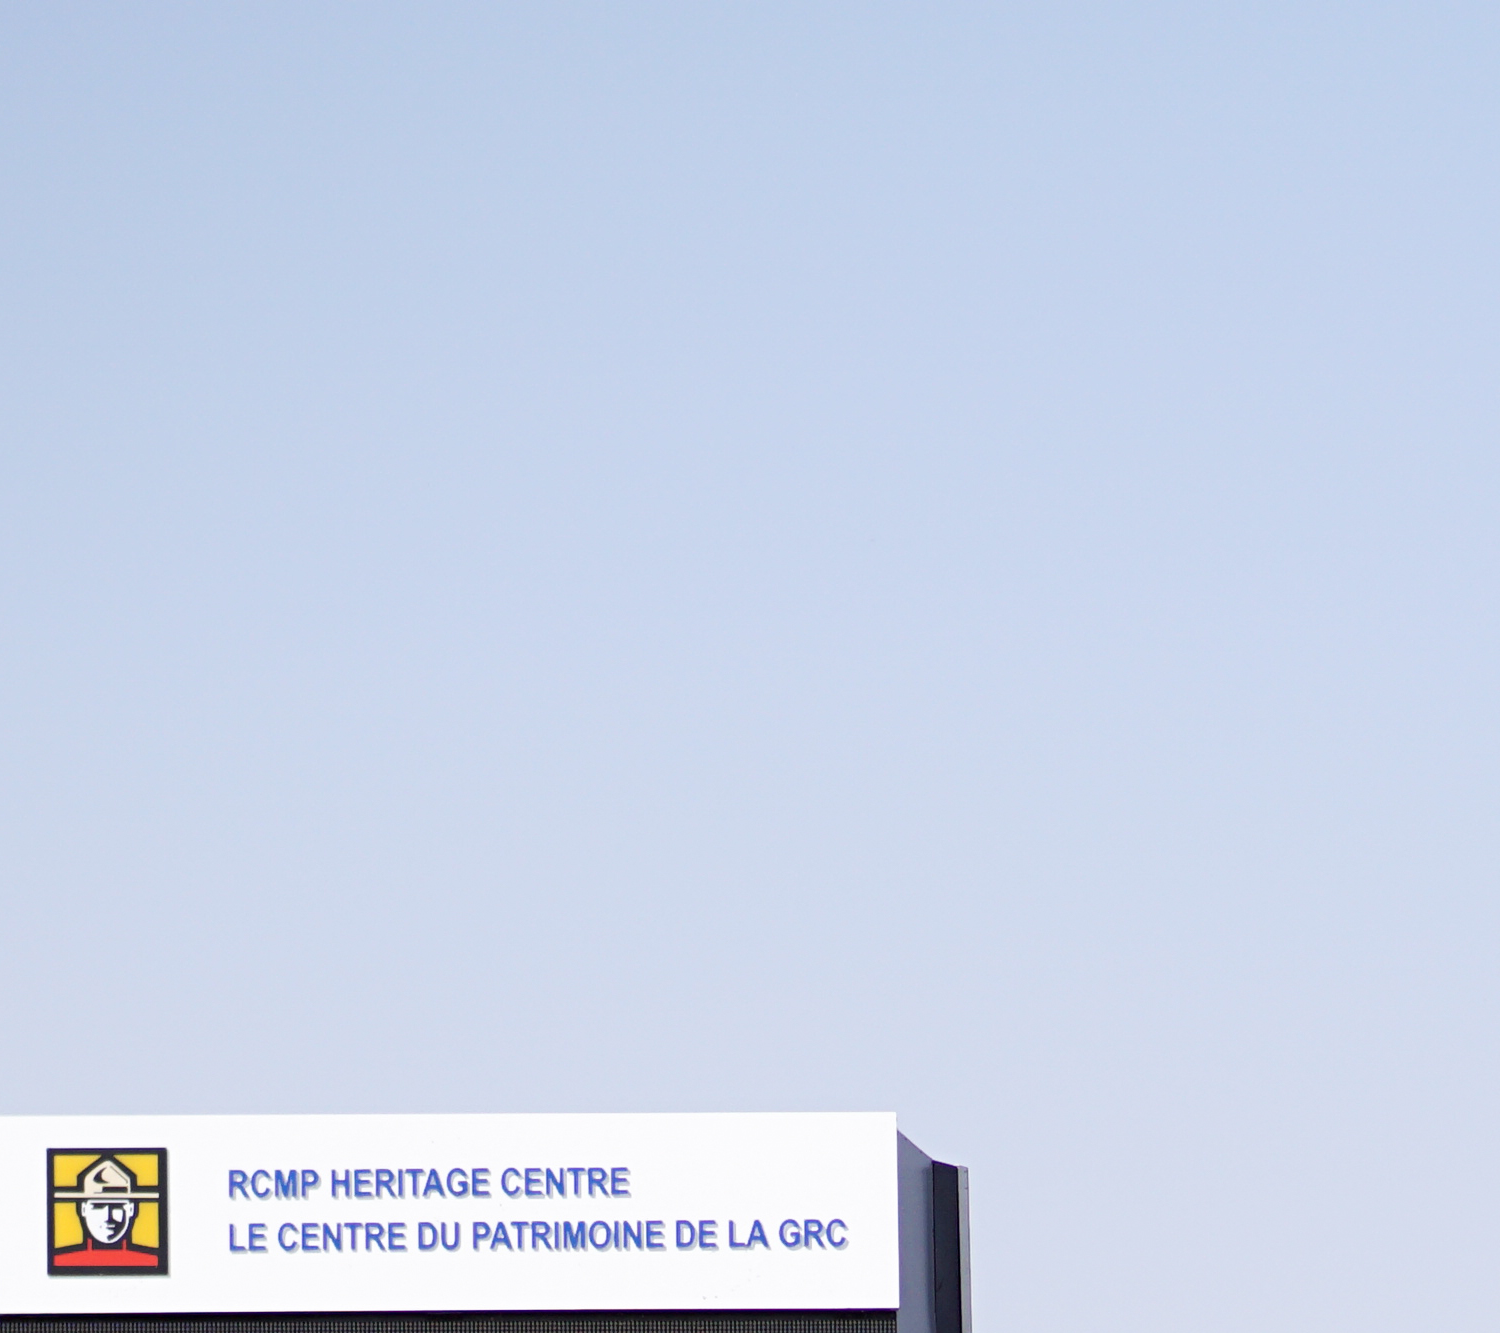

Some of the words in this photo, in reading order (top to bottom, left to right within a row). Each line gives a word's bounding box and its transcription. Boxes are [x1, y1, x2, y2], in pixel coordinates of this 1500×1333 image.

[228, 1169, 320, 1199] RCMP
[330, 1168, 492, 1198] HERITAGE
[500, 1167, 631, 1198] CENTRE
[228, 1223, 267, 1252] LE
[277, 1222, 407, 1252] CENTRE
[418, 1222, 460, 1251] DU
[473, 1220, 666, 1251] PATRIMOINE
[675, 1220, 717, 1250] DE
[729, 1219, 770, 1250] LA
[778, 1218, 849, 1250] GRC
